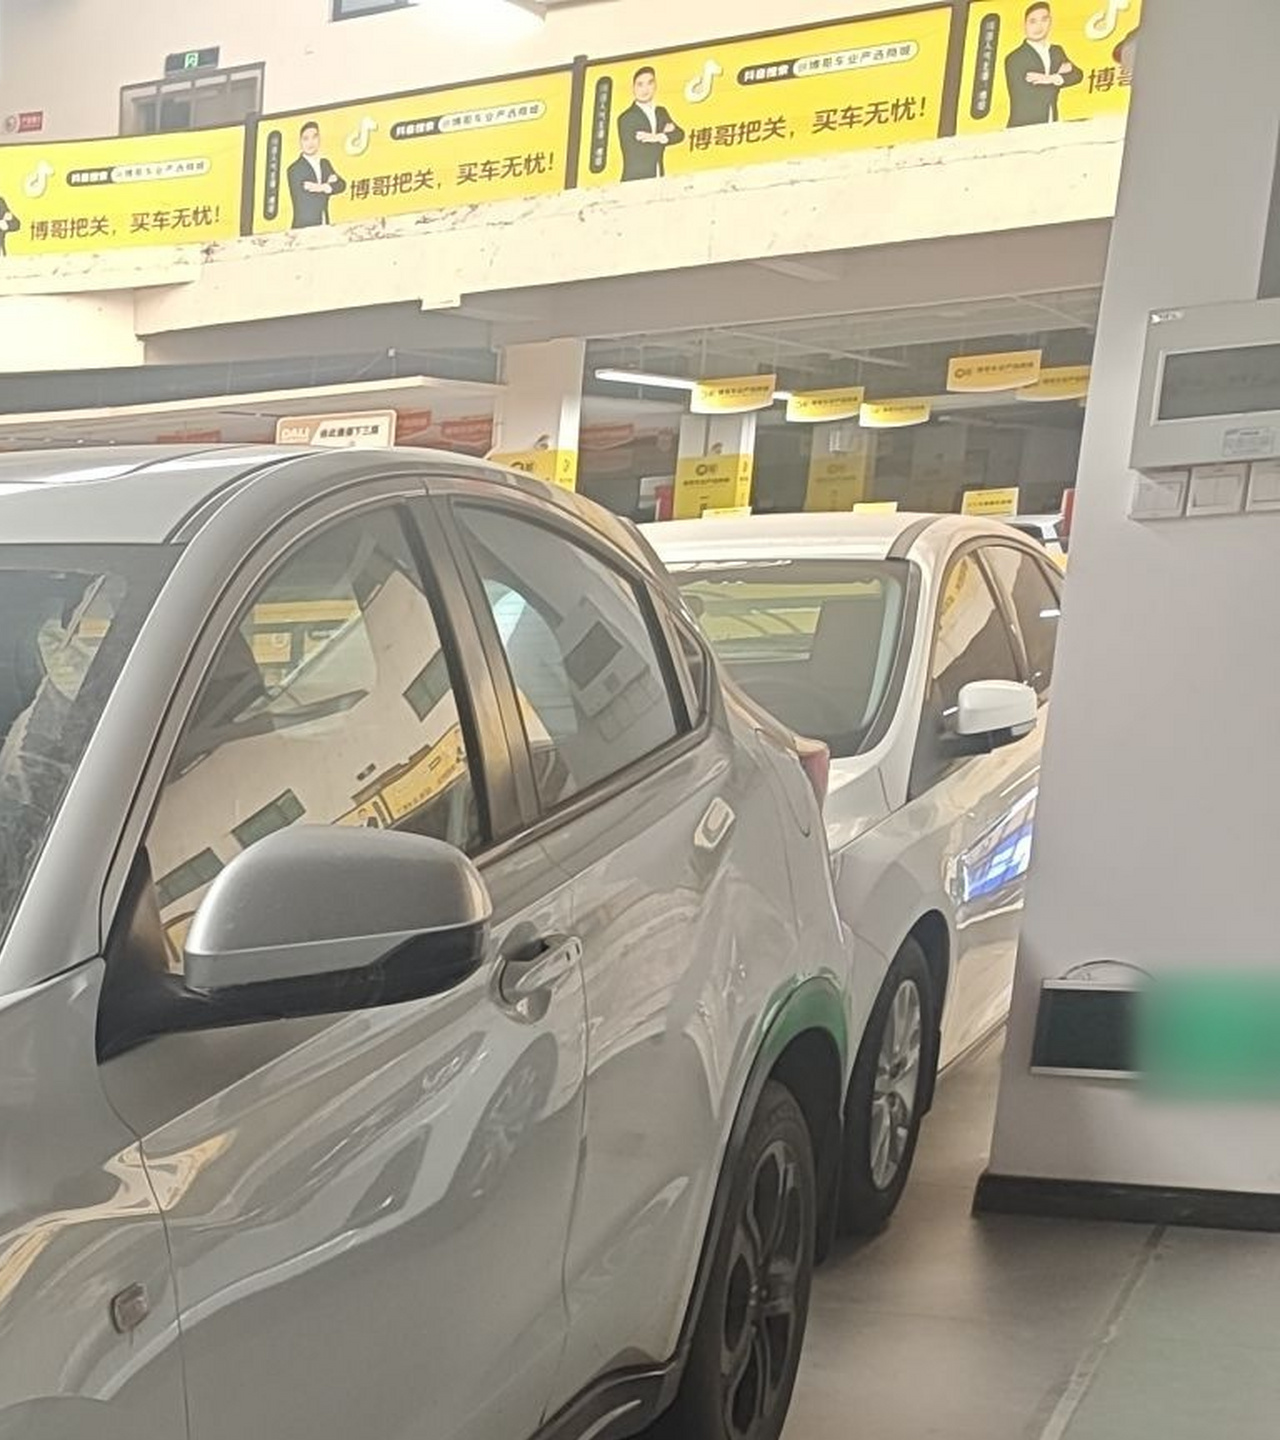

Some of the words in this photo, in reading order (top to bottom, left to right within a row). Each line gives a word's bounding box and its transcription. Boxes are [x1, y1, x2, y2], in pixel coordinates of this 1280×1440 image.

[688, 96, 927, 152] 博哥把关，买车无忧！
[349, 152, 555, 201] 博哥把关，买车无忧！
[30, 205, 221, 241] 博哥把关，买车无忧！
